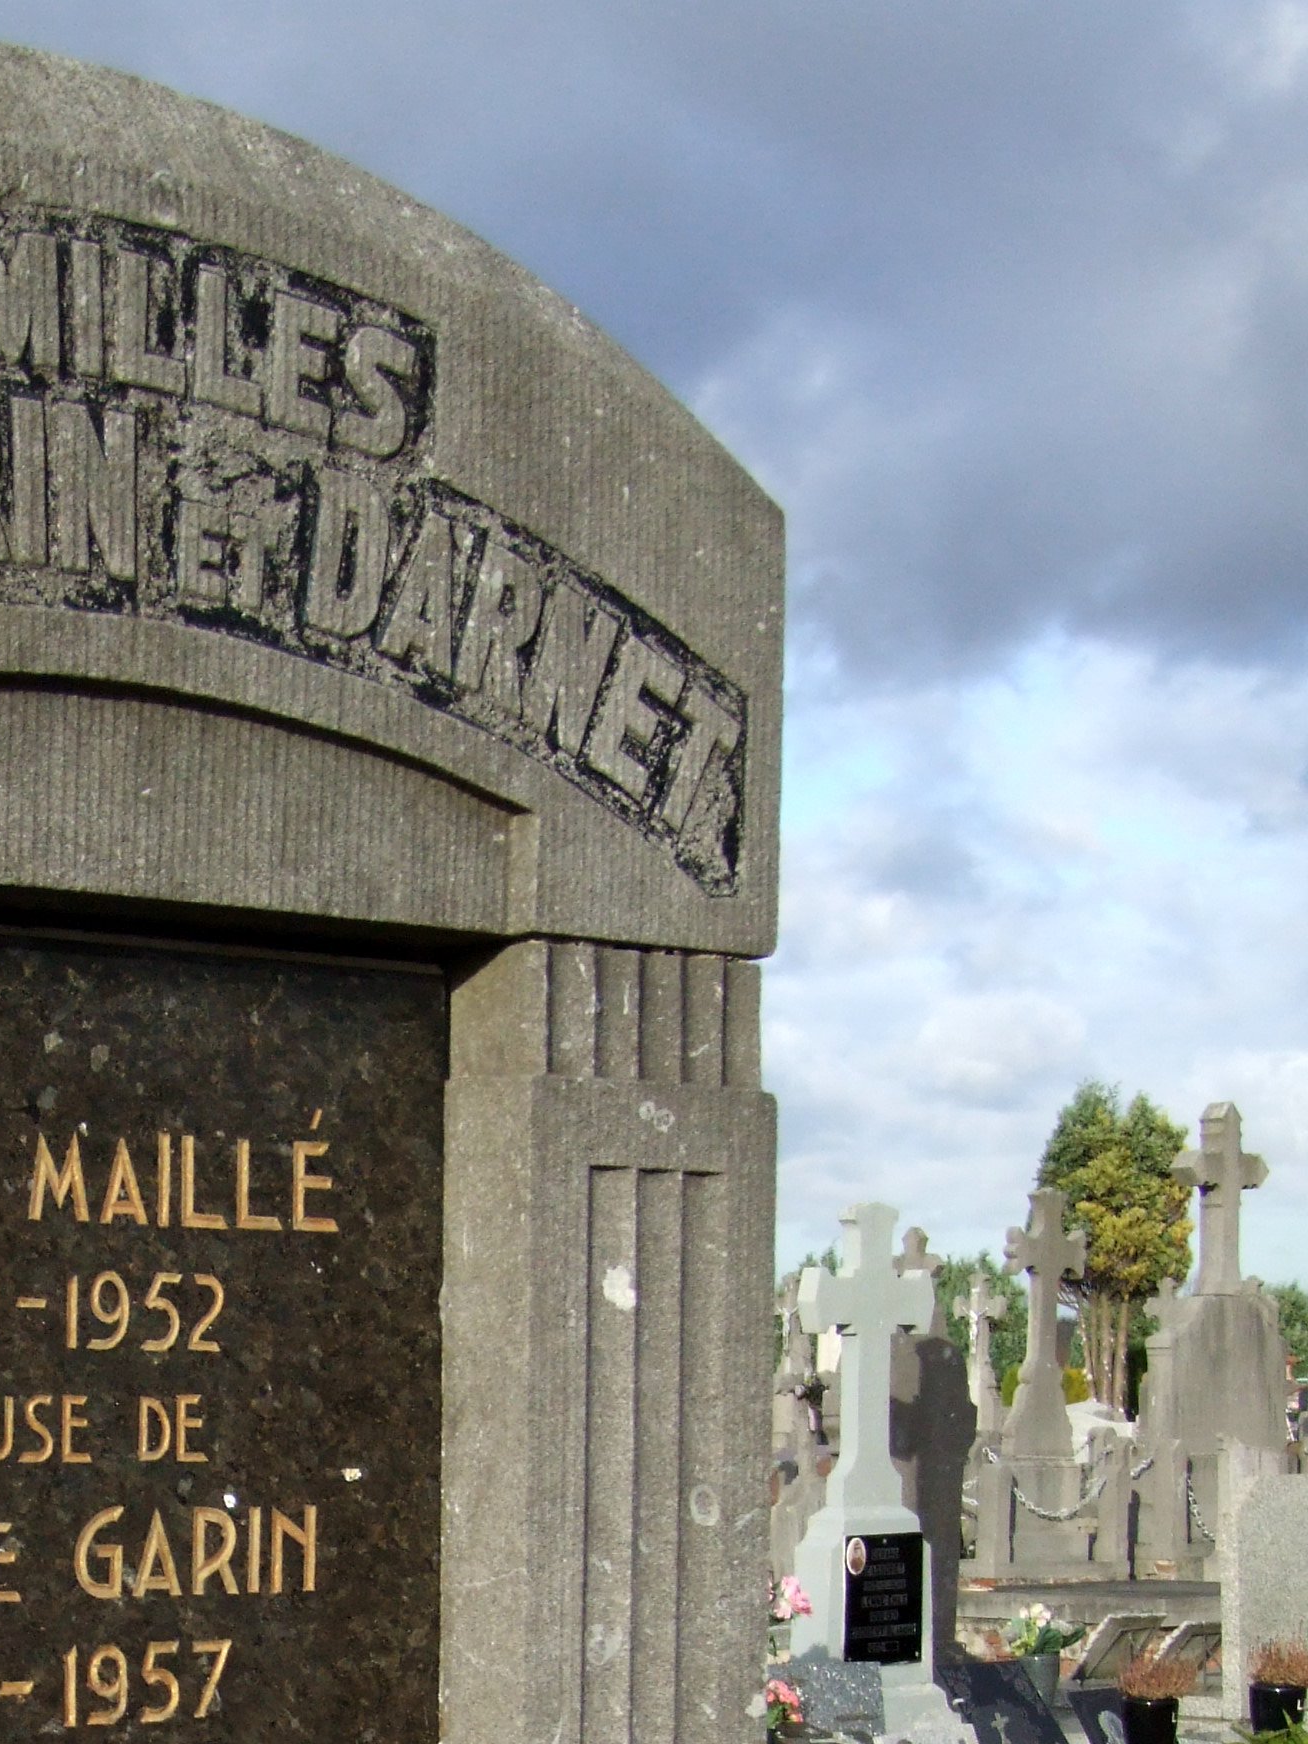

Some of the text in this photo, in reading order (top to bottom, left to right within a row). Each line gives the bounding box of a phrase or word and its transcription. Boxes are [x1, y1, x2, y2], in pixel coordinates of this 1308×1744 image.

[179, 500, 294, 610] ET
[303, 464, 743, 858] DARNET
[28, 1109, 338, 1233] MAILLÉ
[138, 1394, 208, 1463] DE
[74, 1504, 318, 1600] GARIN
